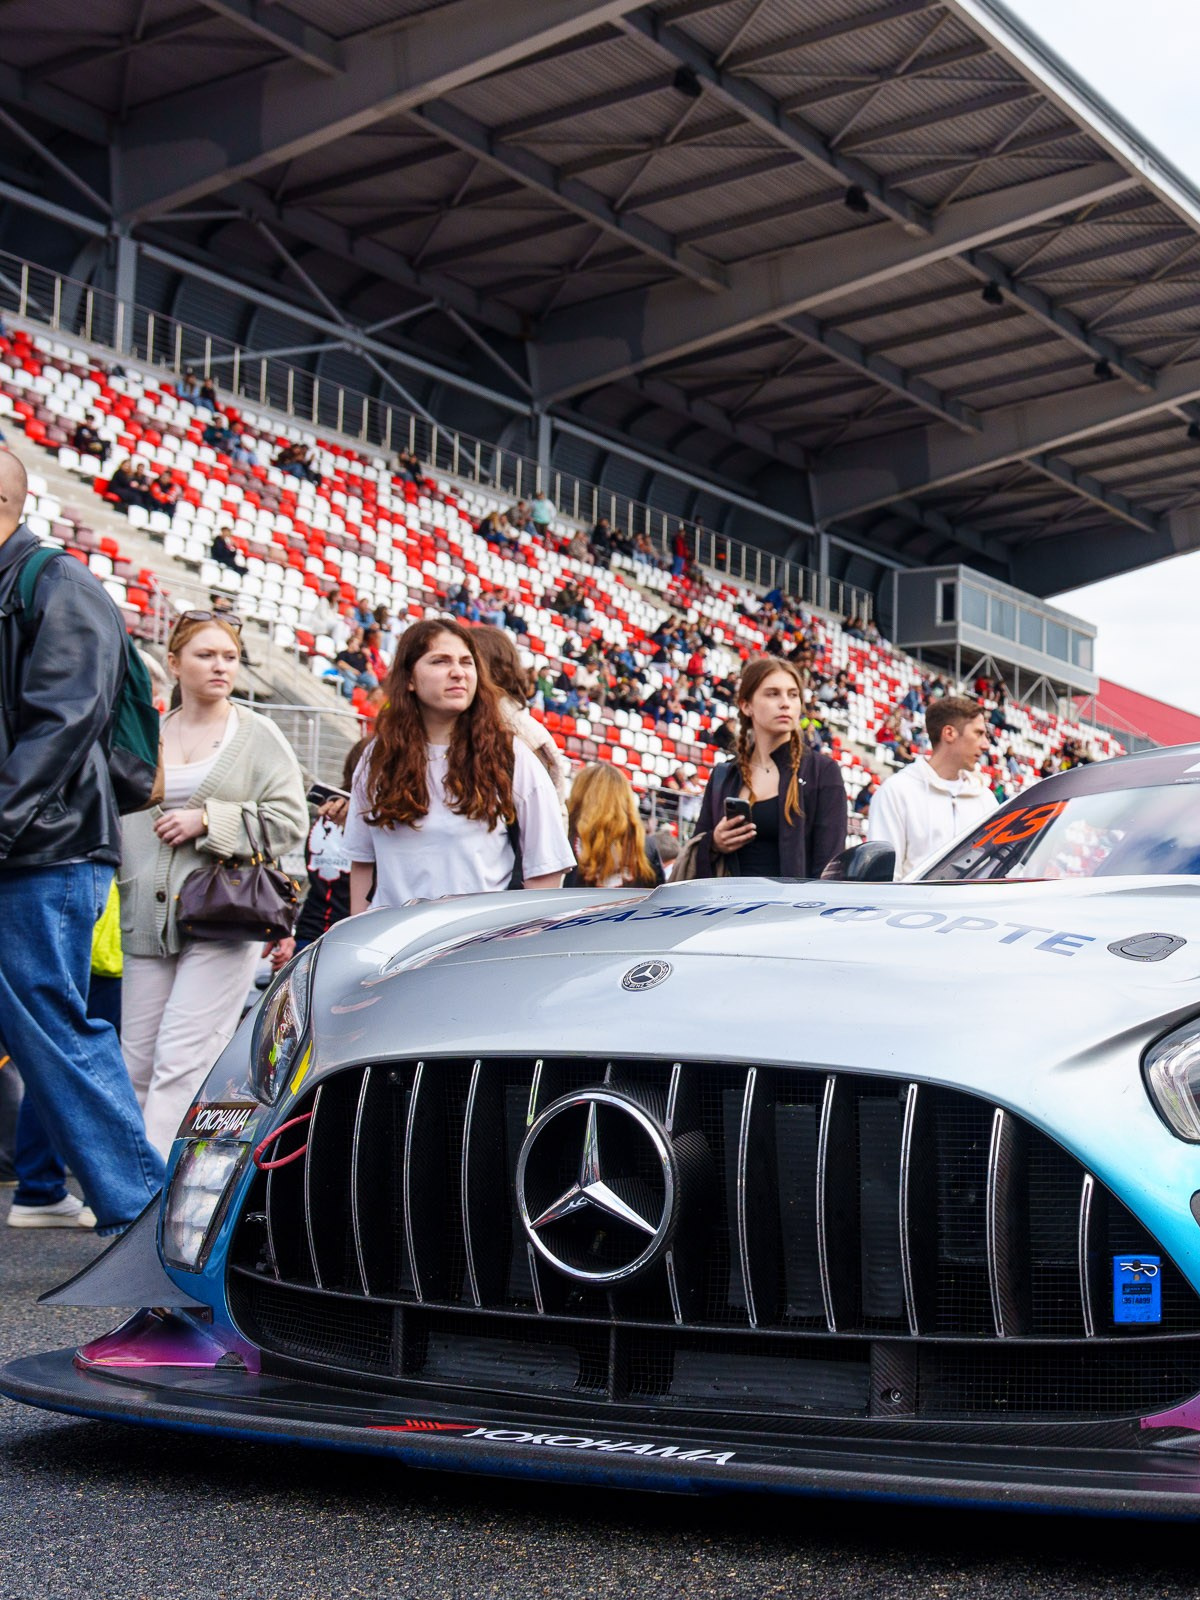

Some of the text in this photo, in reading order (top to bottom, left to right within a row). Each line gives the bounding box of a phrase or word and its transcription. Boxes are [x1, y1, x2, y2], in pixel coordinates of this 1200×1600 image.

[972, 801, 1069, 849] 13
[819, 905, 1097, 957] ФОРТЕ
[190, 1108, 252, 1131] YOKOHAMA
[462, 1427, 737, 1466] YOKOHAMA
